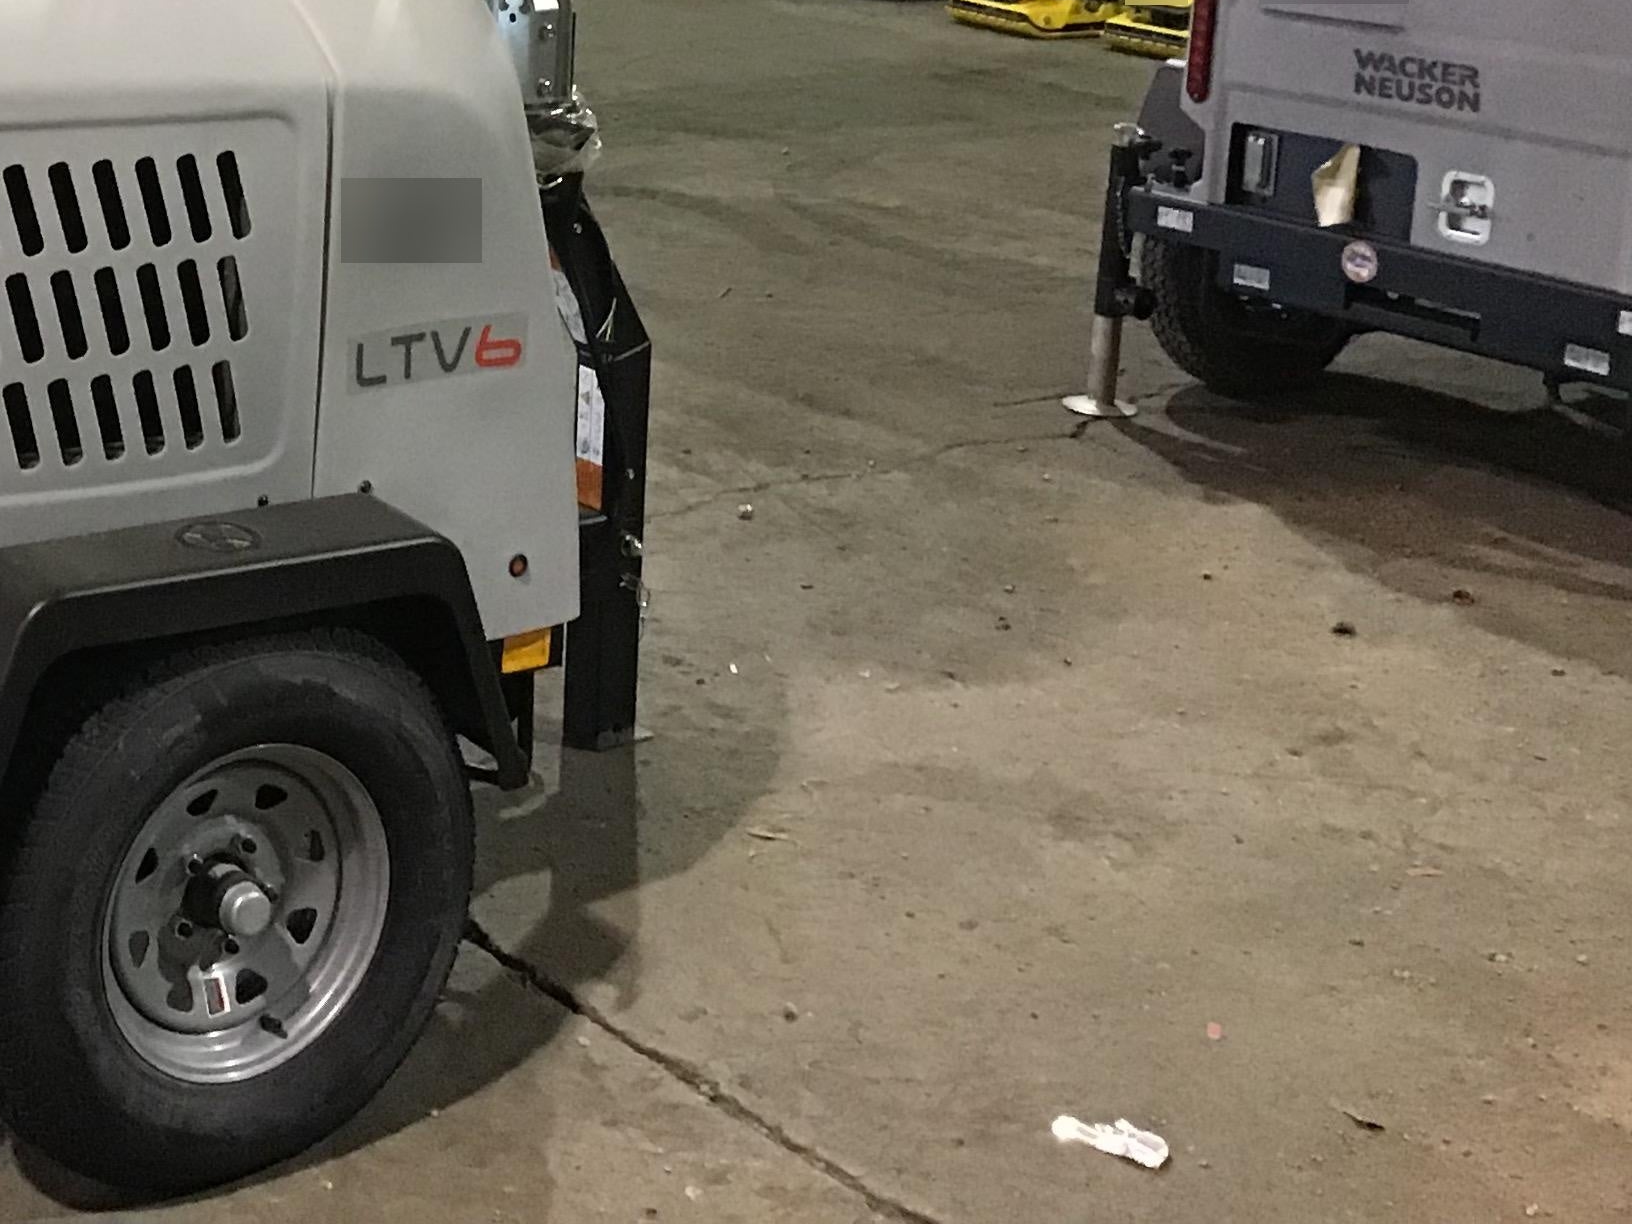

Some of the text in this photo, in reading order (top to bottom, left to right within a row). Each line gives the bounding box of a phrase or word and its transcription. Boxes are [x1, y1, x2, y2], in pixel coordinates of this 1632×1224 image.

[1354, 48, 1480, 88] WACKER
[1354, 72, 1480, 112] NEUSON
[355, 324, 522, 387] LTV6
